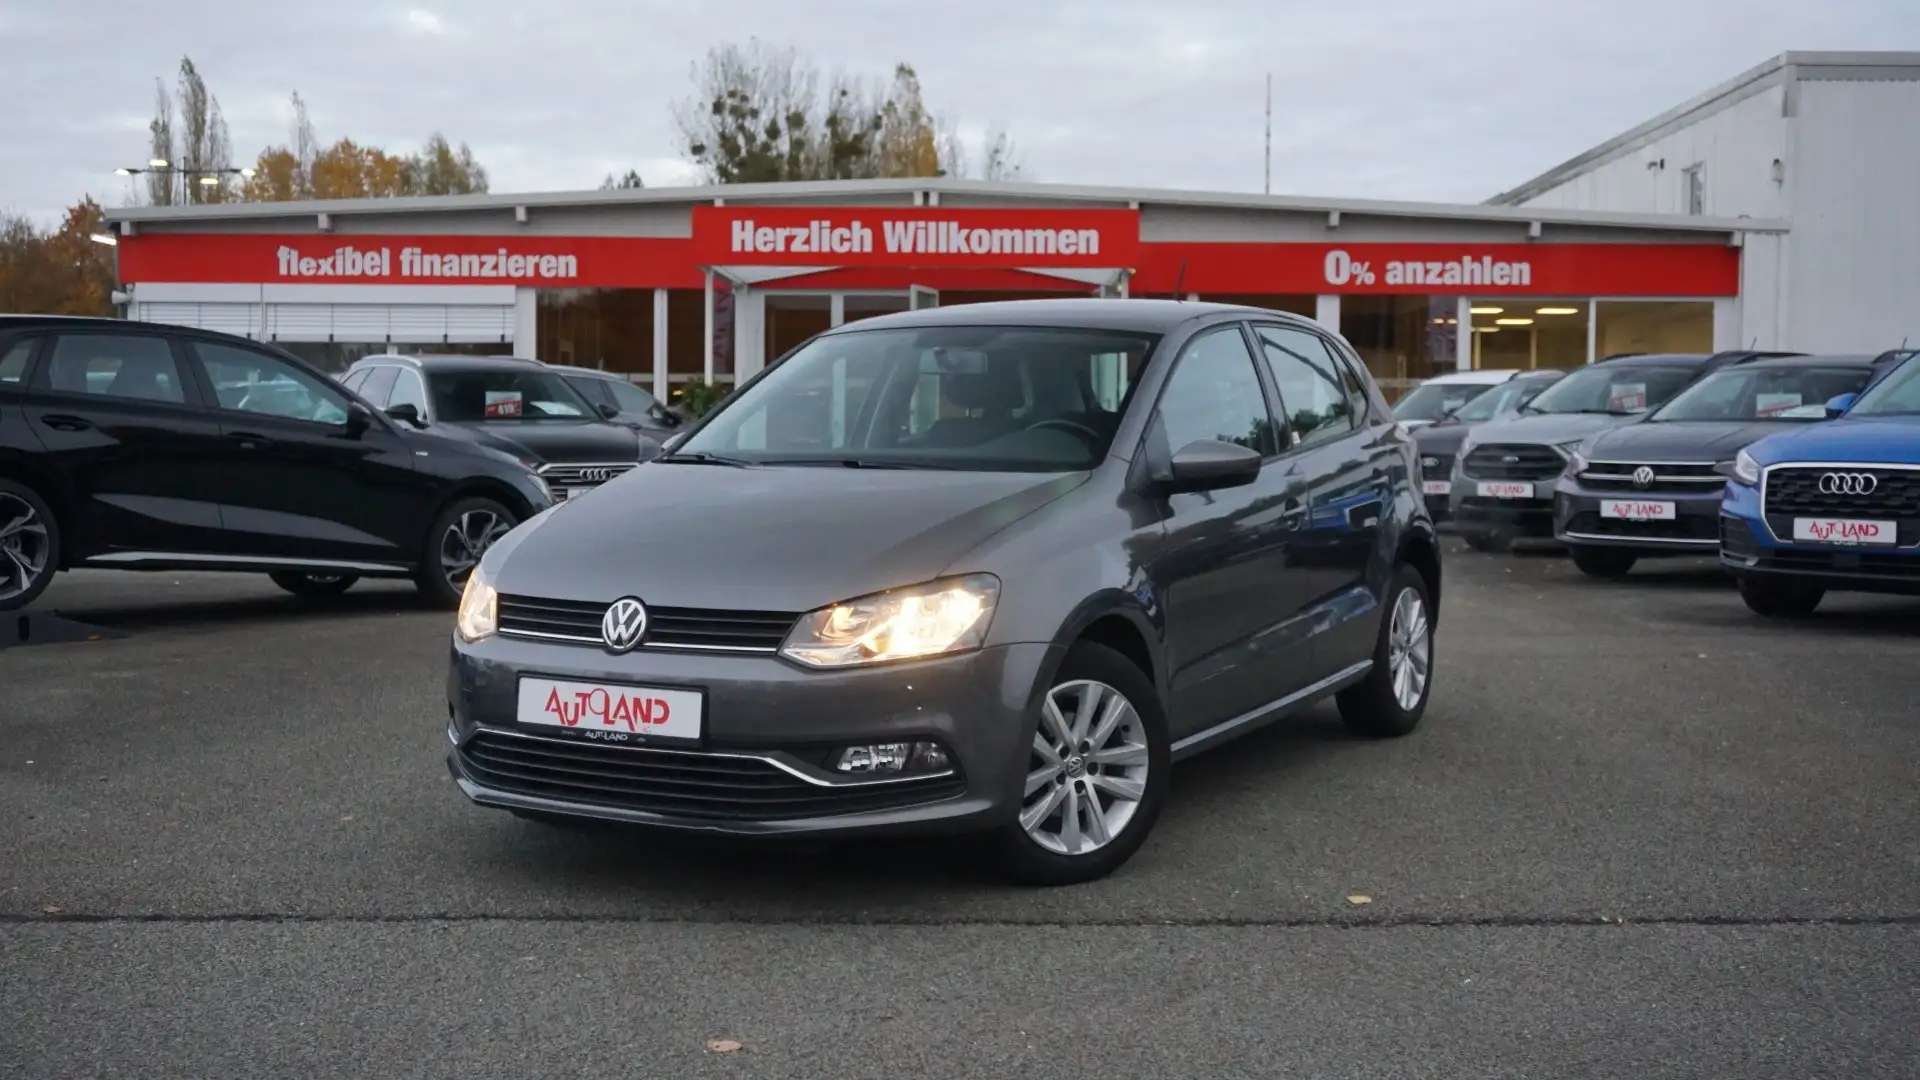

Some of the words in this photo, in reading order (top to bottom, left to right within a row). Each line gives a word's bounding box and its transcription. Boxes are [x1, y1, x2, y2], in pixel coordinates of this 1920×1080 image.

[730, 219, 873, 254] Herzlich
[882, 220, 1100, 255] Willkommen
[278, 245, 390, 277] flexibel
[399, 247, 578, 278] finanzieren
[1323, 249, 1376, 286] 0%
[1386, 255, 1531, 286] anzahlen
[545, 685, 670, 733] AUTOLAND
[585, 731, 628, 742] AUTOLAND
